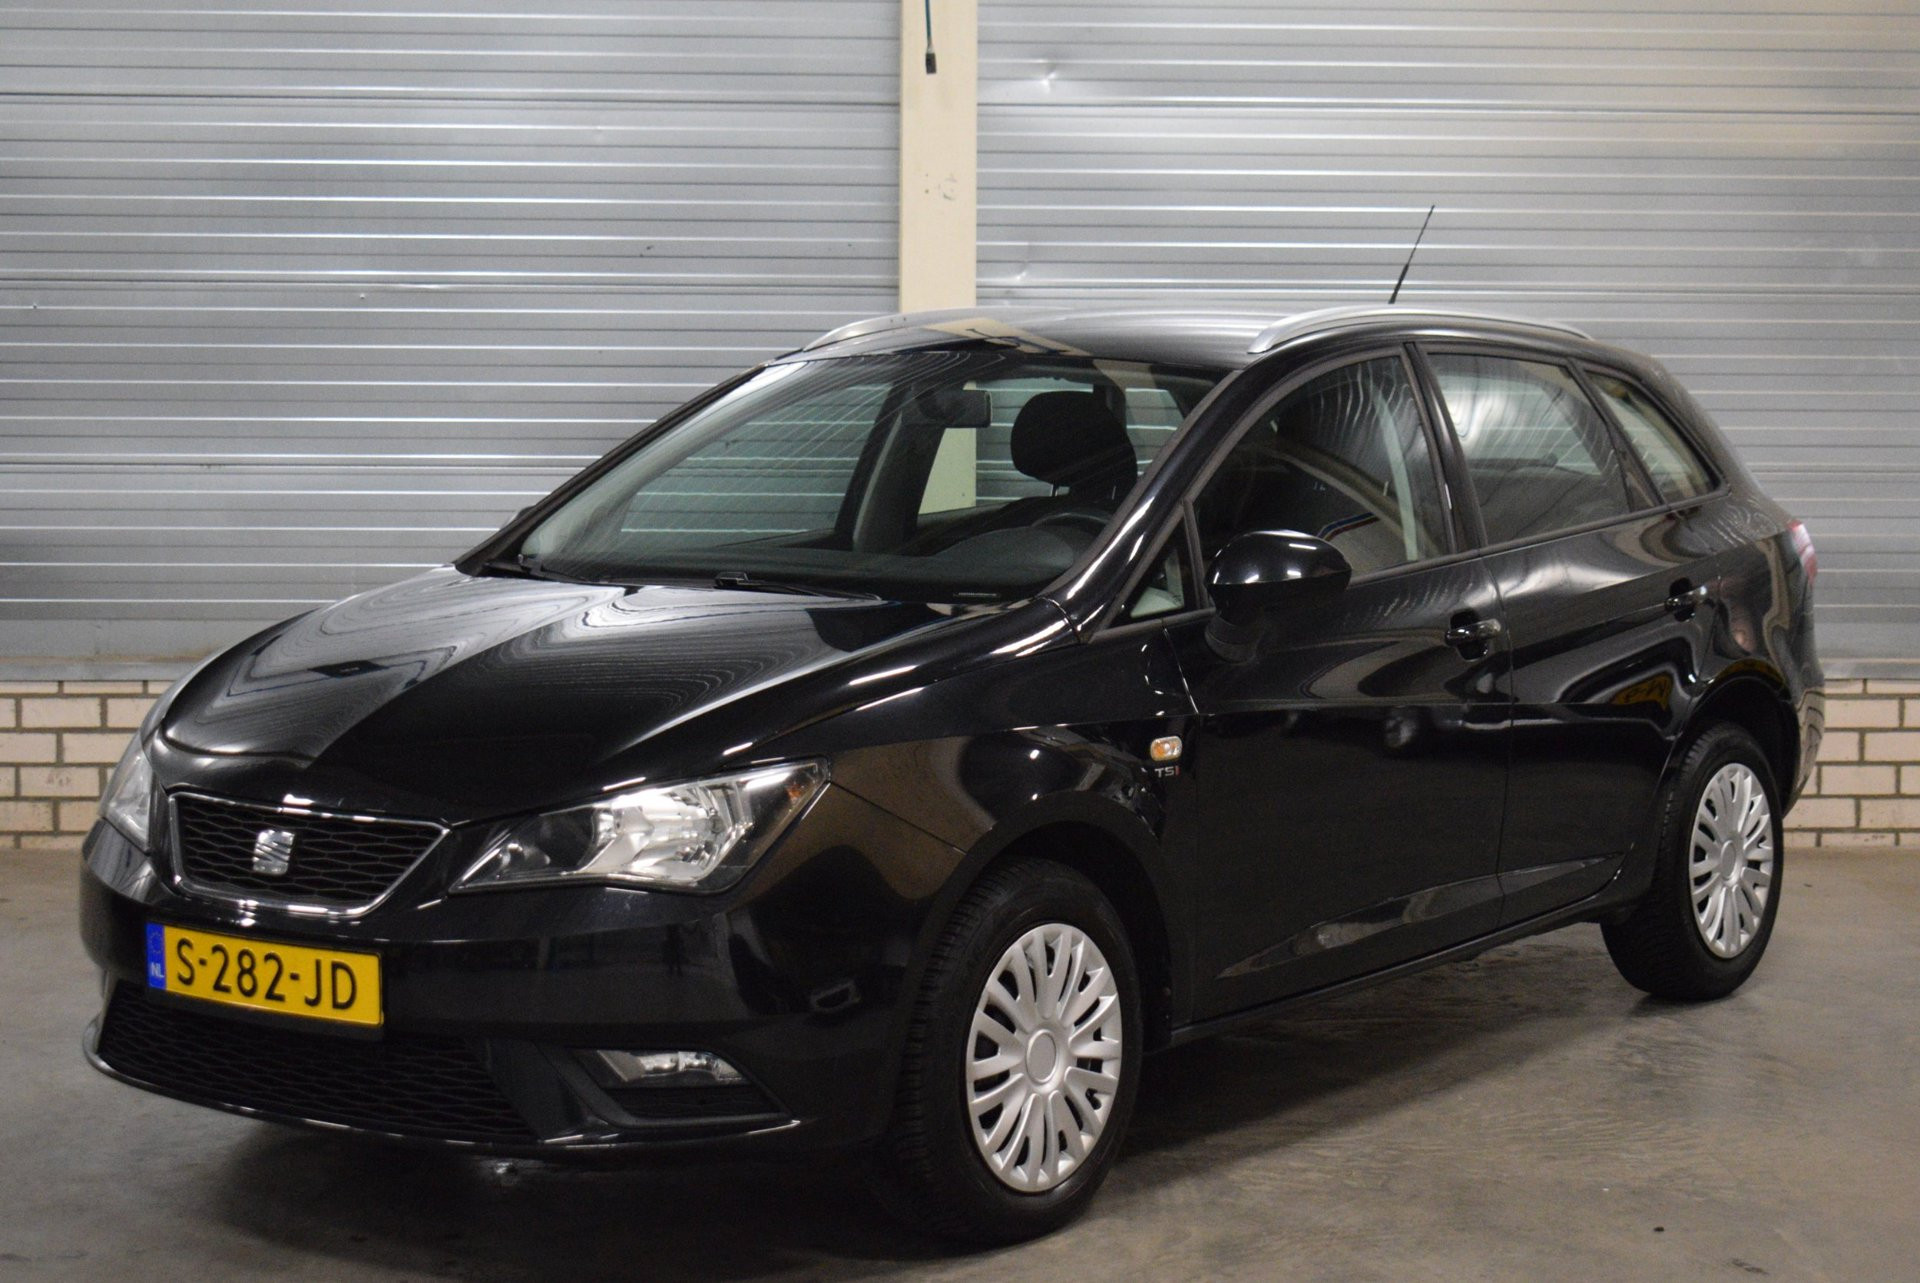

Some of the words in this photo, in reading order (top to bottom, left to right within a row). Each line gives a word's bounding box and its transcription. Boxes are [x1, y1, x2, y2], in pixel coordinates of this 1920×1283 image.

[1154, 765, 1180, 778] TSI
[151, 962, 164, 979] NL
[176, 937, 357, 1010] S-282-JD
